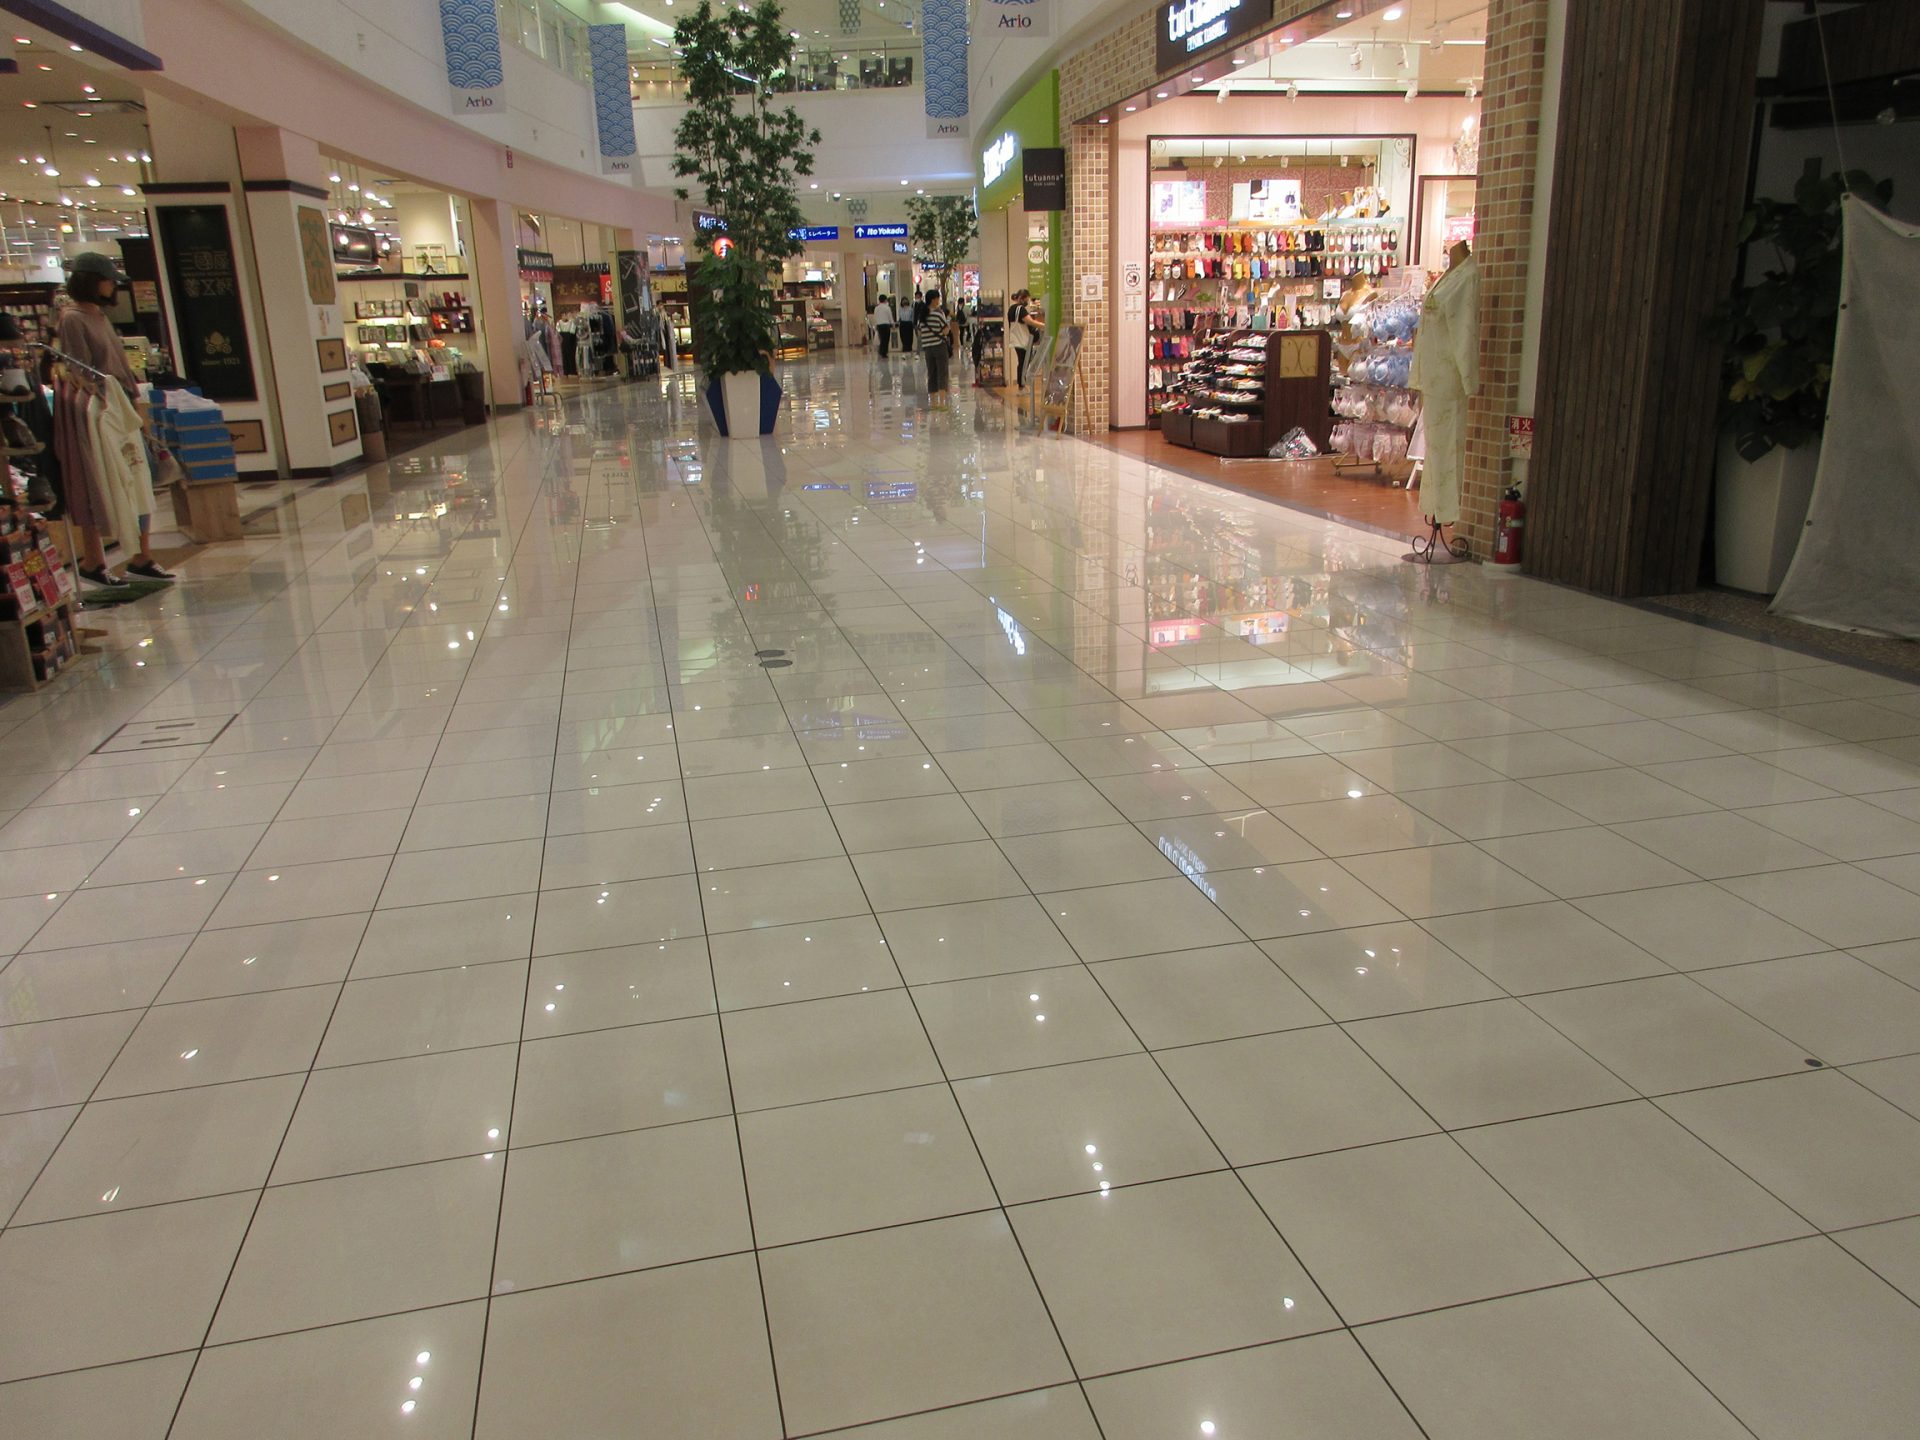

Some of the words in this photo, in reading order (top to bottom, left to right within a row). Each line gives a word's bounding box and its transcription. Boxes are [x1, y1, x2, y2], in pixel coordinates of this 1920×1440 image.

[998, 14, 1032, 28] Ario
[466, 96, 493, 107] Ario
[937, 125, 959, 133] Ario
